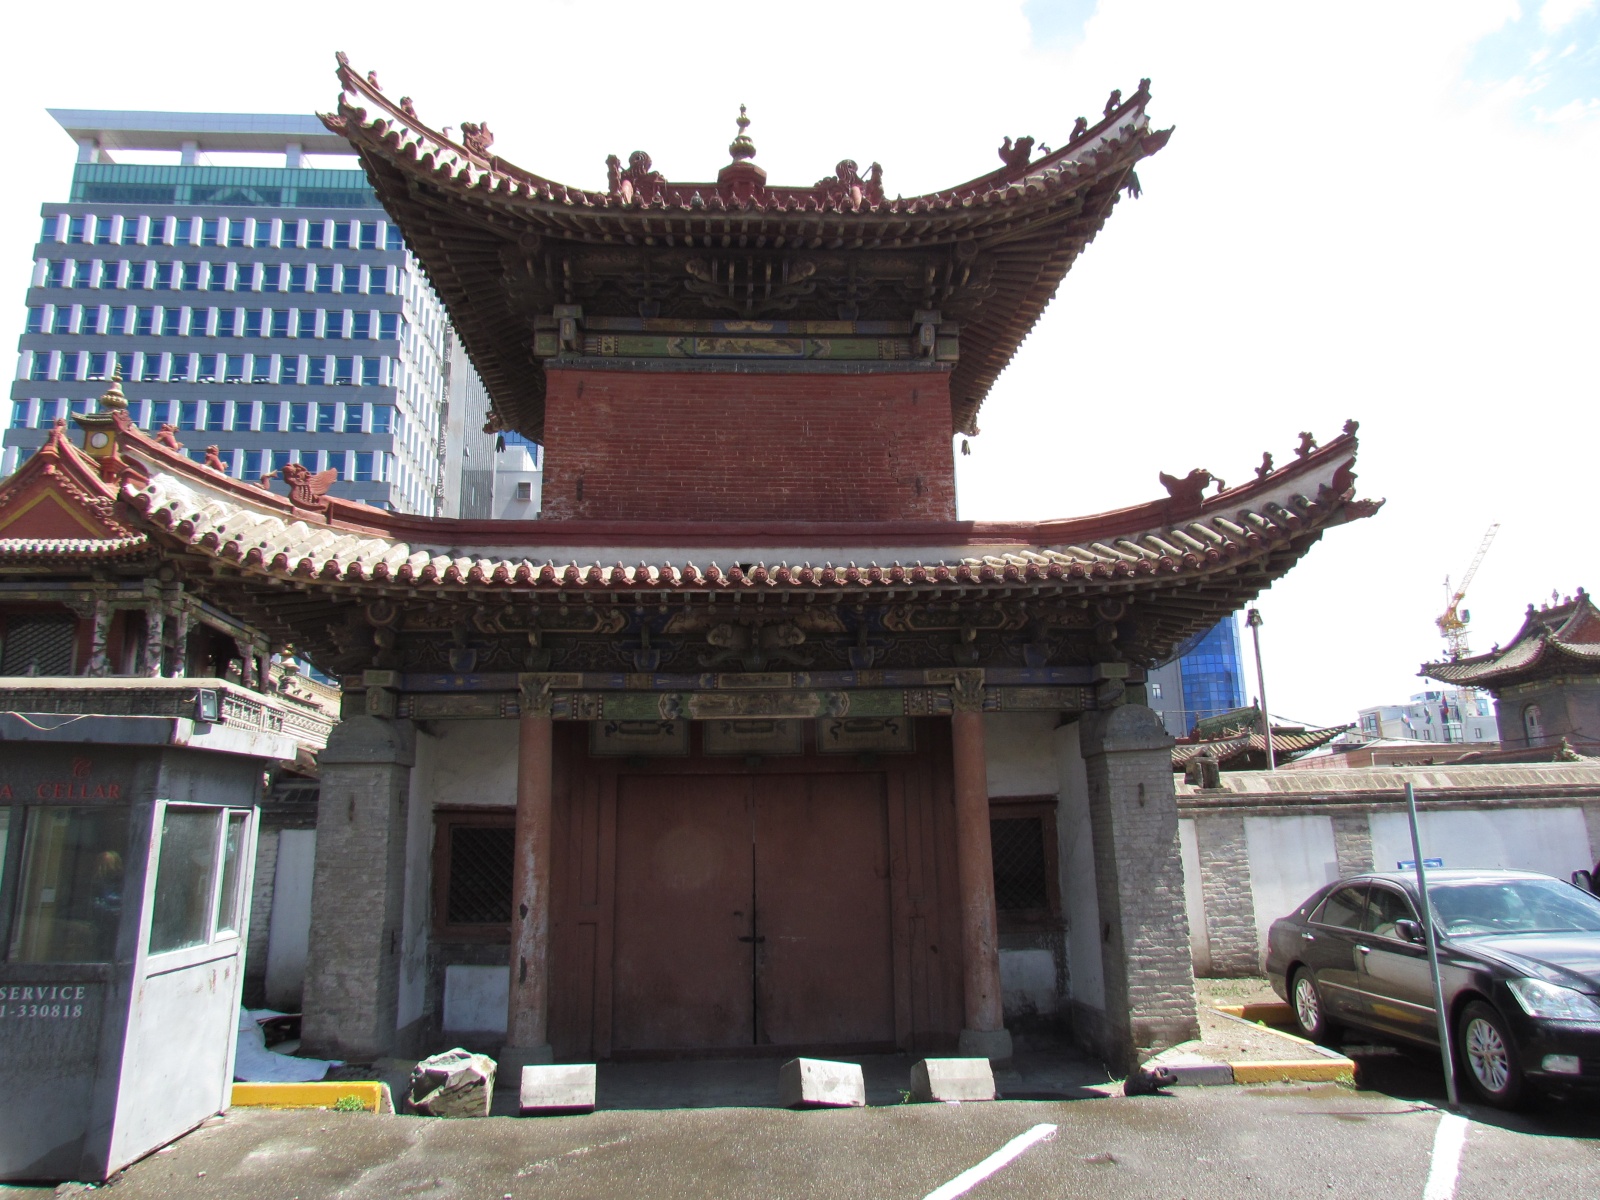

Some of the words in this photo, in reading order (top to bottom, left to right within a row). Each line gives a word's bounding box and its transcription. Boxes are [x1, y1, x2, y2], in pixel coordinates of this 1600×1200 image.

[37, 783, 121, 799] CELLAR
[0, 986, 85, 1000] SERVICE
[0, 1004, 83, 1018] 1-330818
